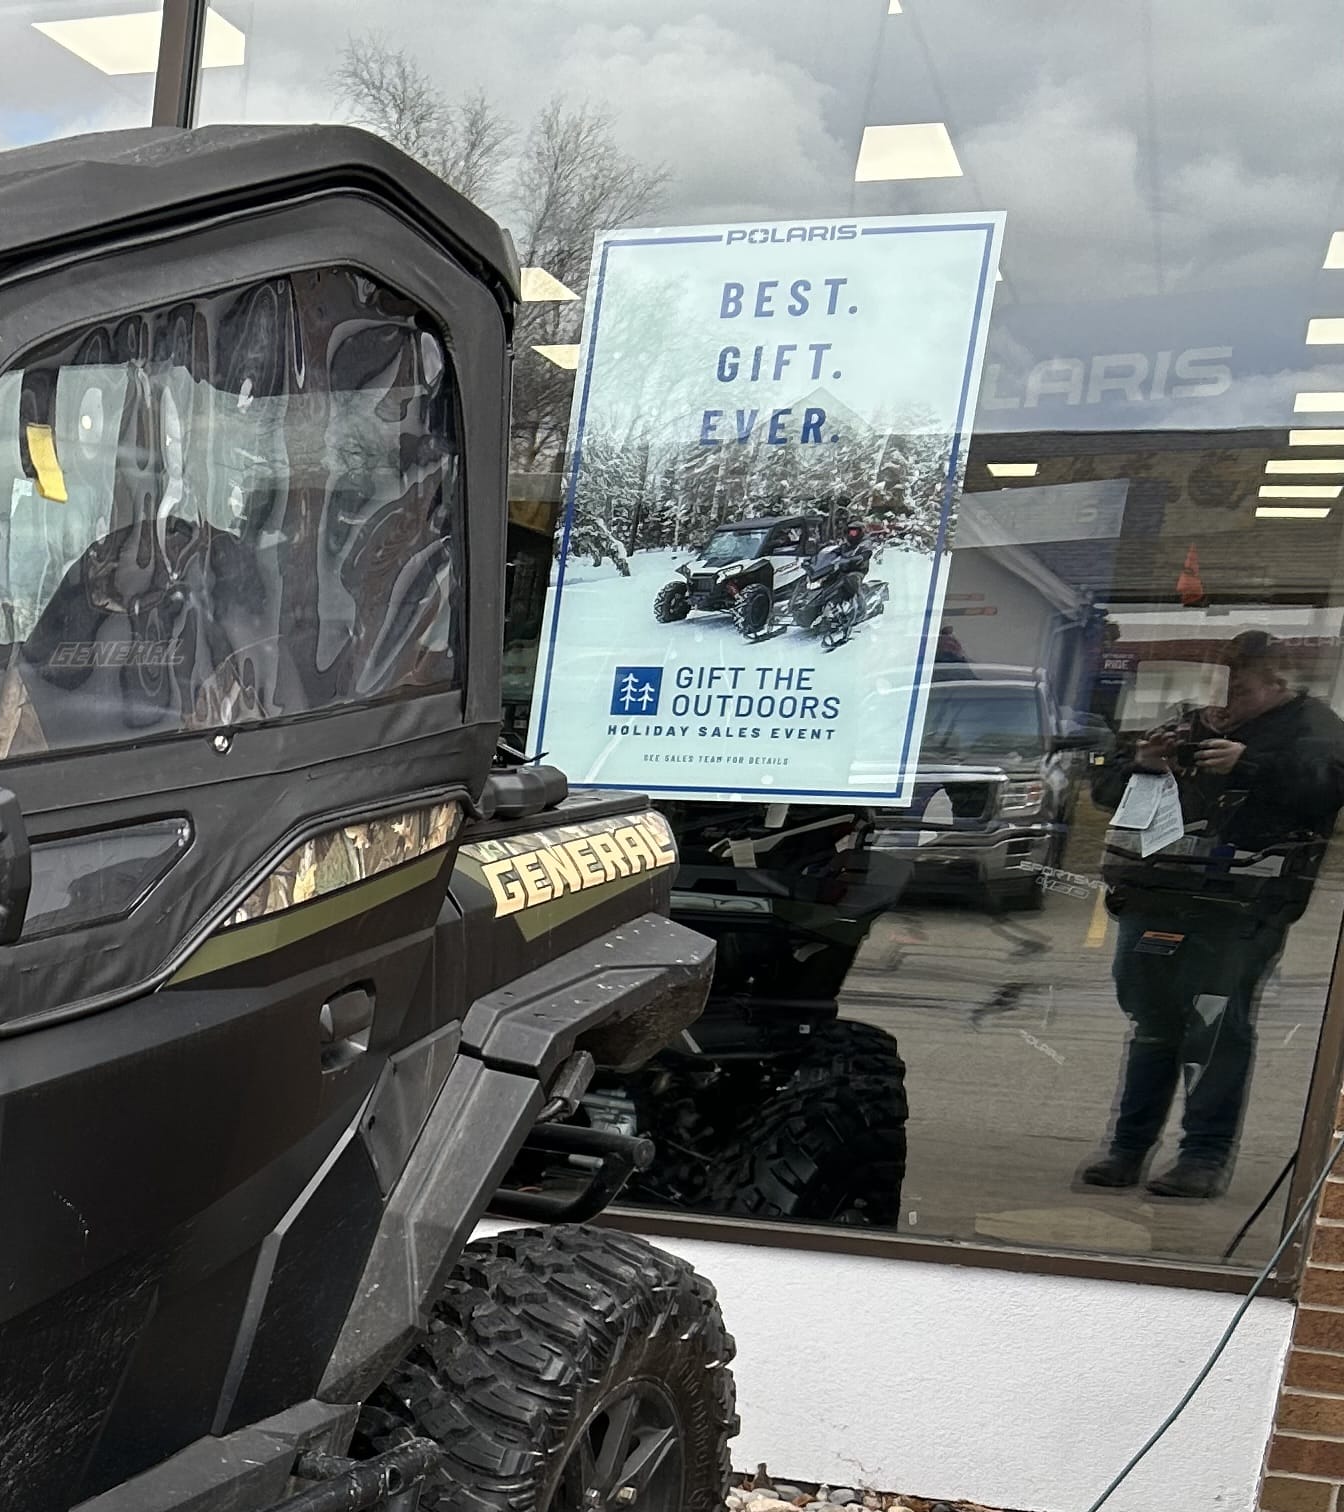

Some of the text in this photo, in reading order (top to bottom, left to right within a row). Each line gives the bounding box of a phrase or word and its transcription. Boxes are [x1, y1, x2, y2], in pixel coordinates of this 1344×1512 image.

[726, 223, 858, 245] POLARIS
[719, 277, 858, 319] BEST.
[716, 342, 843, 383] GIFT.
[983, 346, 1233, 411] LARIS
[699, 407, 841, 446] EVER.
[49, 639, 185, 667] GENERAL
[675, 666, 815, 691] GIFT THE
[671, 694, 841, 720] OUTDOORS
[607, 725, 837, 741] HOLIDAY SALES EVENT
[664, 754, 694, 763] SALES
[698, 755, 723, 763] TEAM
[726, 756, 744, 764] FOR
[748, 757, 789, 766] DETAILS
[480, 823, 675, 918] GENERAL
